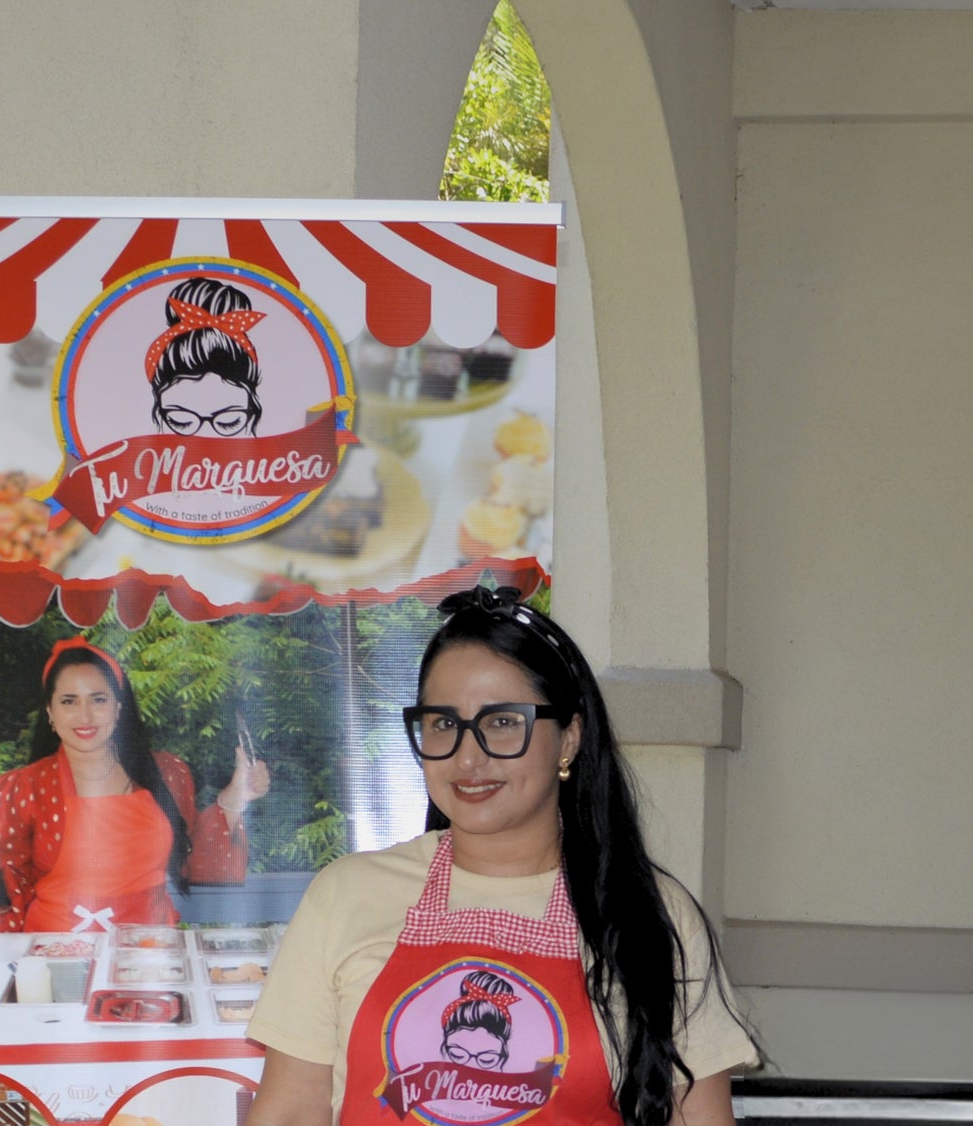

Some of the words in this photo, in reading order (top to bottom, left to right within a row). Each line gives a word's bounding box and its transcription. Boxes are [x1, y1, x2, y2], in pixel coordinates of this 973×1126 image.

[69, 440, 128, 516] Tu
[133, 445, 330, 500] Marquesa
[171, 510, 178, 519] a
[181, 511, 208, 522] taste
[210, 510, 222, 520] of
[225, 500, 268, 519] tradition
[390, 1063, 424, 1113] Tu
[425, 1069, 546, 1108] Marquesa
